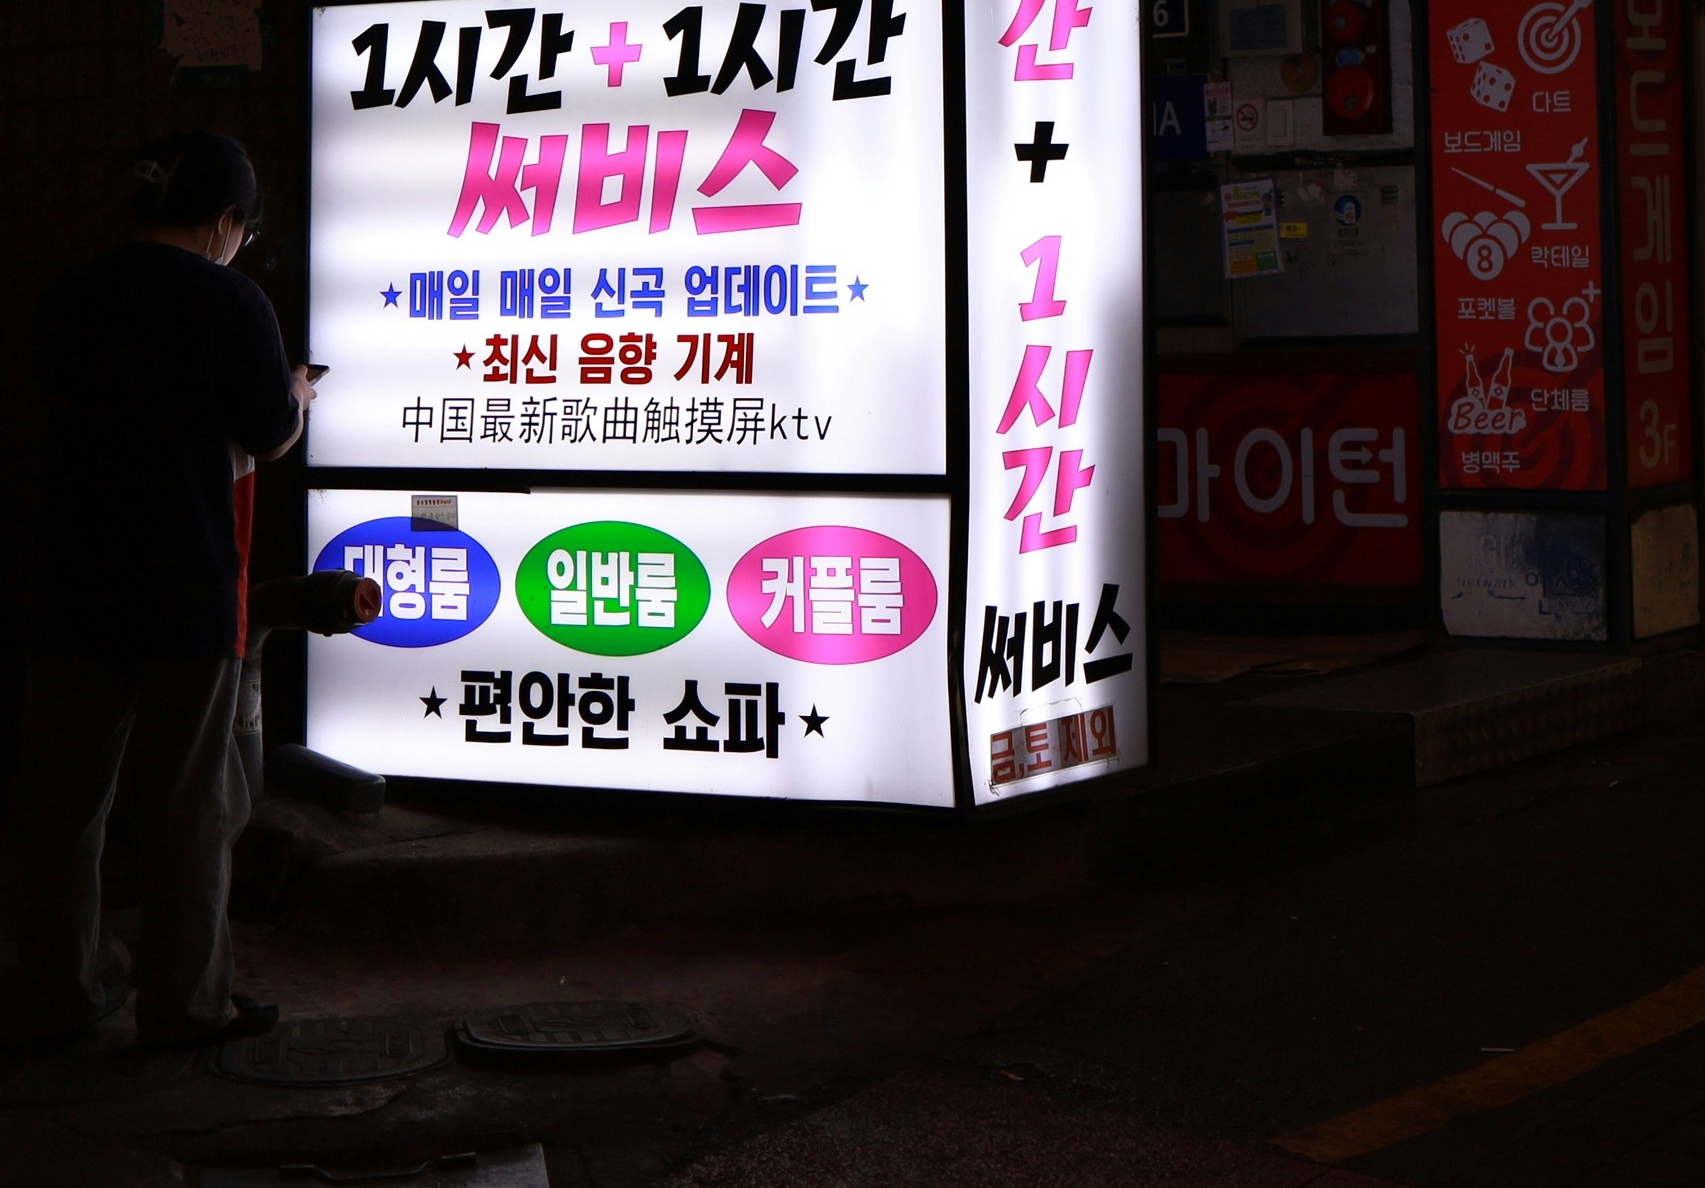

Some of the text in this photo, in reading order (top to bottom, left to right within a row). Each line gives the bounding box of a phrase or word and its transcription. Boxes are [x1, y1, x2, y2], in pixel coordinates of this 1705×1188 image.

[350, 6, 575, 115] 1시간
[1531, 90, 1572, 115] 다트
[1443, 130, 1521, 155] 보드게임
[447, 108, 803, 238] 써비스
[1475, 243, 1495, 273] 8
[1530, 245, 1590, 269] 칵테일
[409, 264, 841, 321] 매일 매일 신곡 업데이트
[1457, 297, 1516, 320] 포켓볼
[481, 331, 756, 385] 최신 음향 기계
[402, 397, 832, 445] 中国最新歌曲触摸屏ktv
[995, 235, 1096, 555] 1시간
[1452, 402, 1525, 433] Beer
[1529, 387, 1590, 413] 단체룸
[1460, 450, 1521, 474] 병맥주
[1637, 398, 1678, 469] 3F
[1156, 425, 1409, 528] 마이턴
[546, 548, 679, 630] 일반룸
[760, 555, 904, 636] 커플룸
[973, 583, 1133, 705] 써비스
[458, 669, 786, 759] 편안한 쇼파
[990, 705, 1117, 785] 금,토 제외
